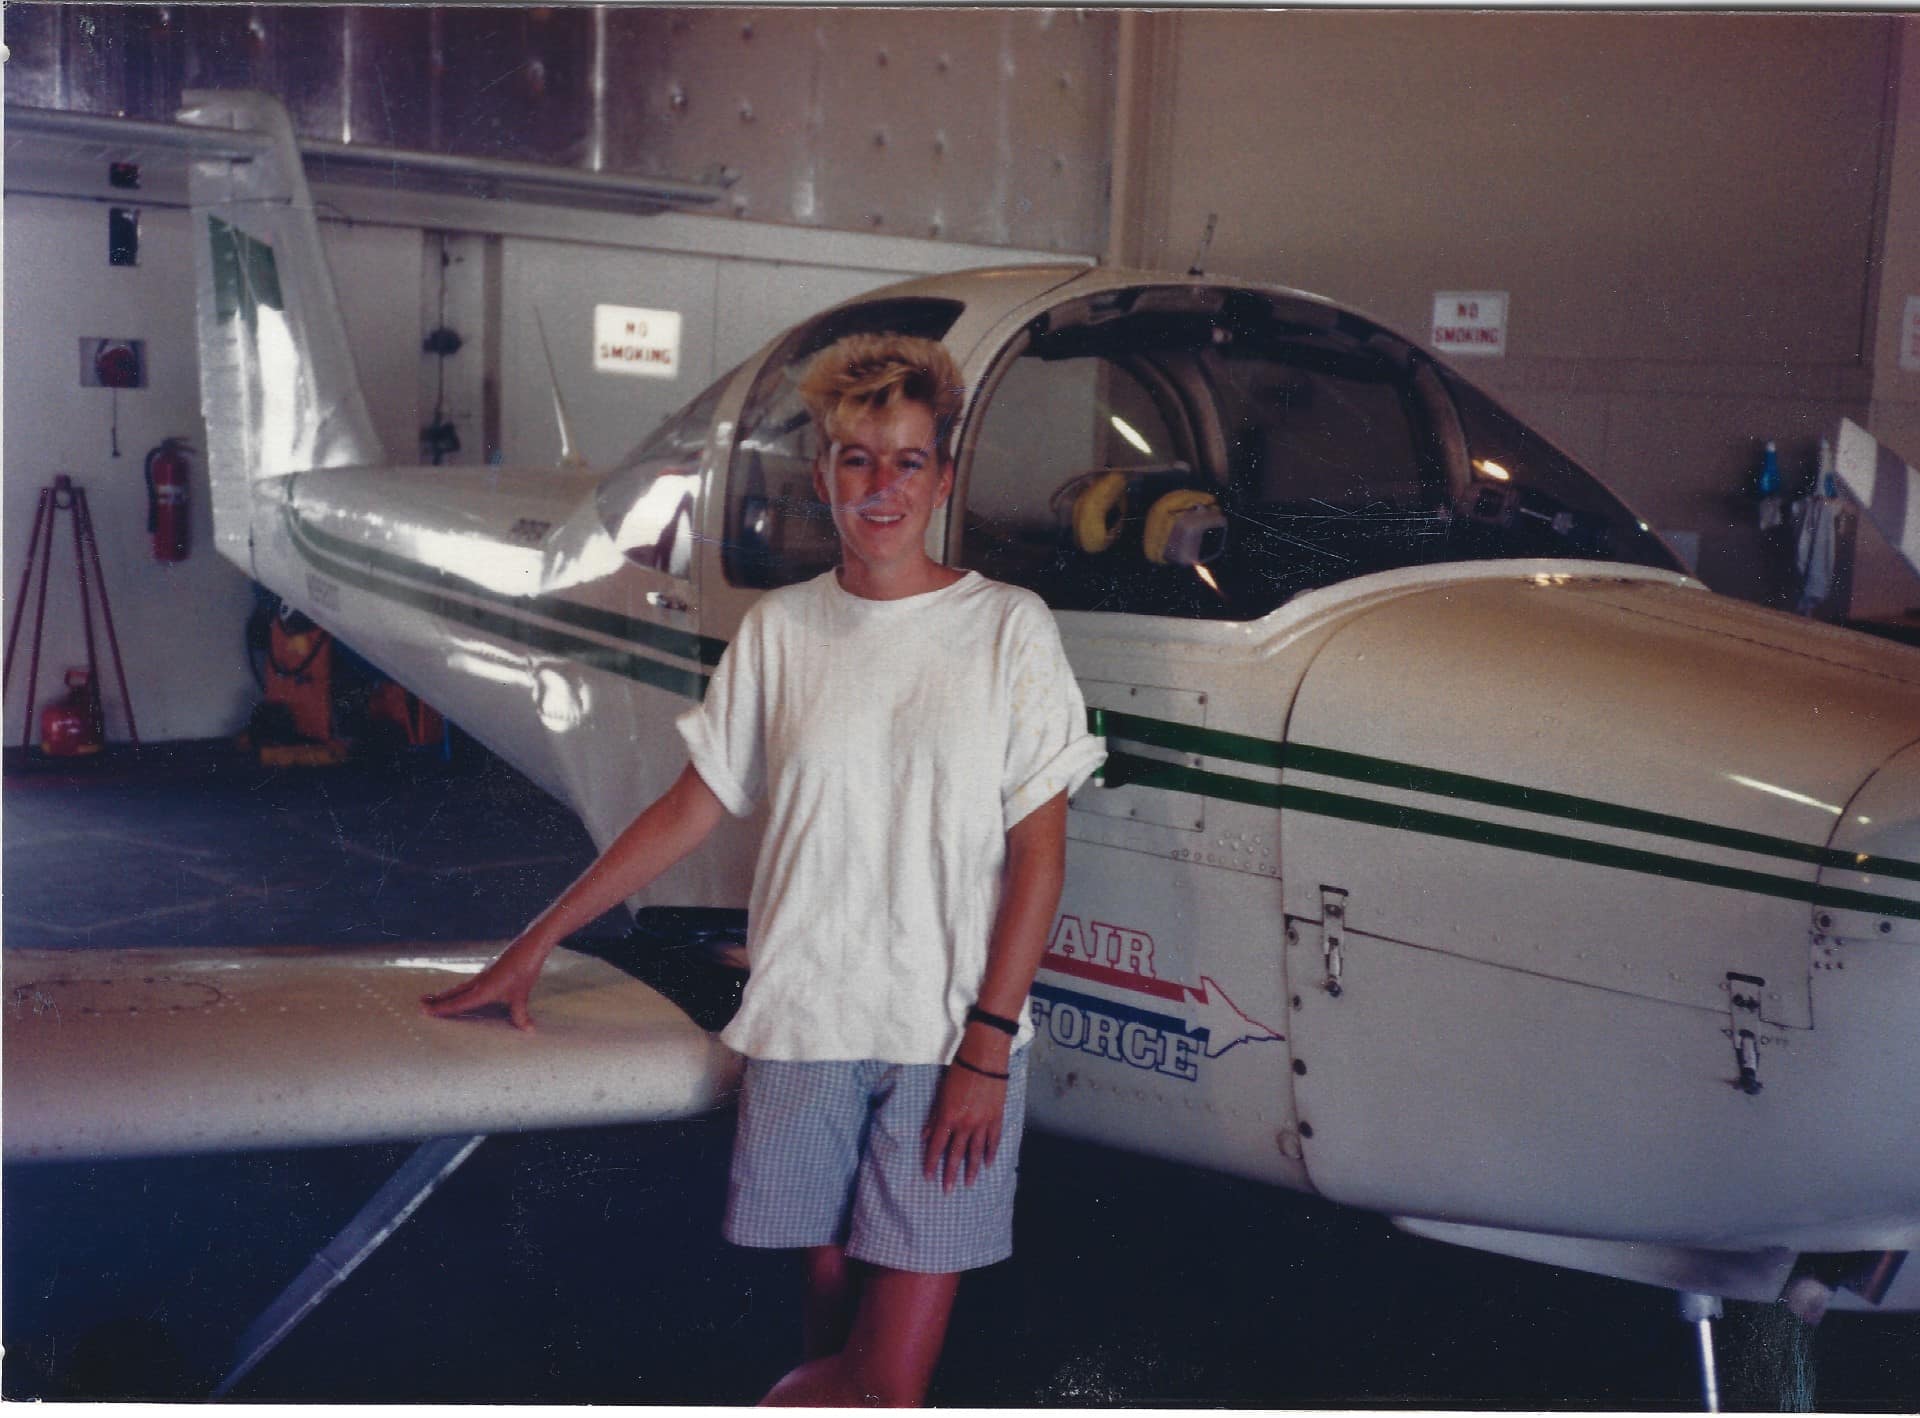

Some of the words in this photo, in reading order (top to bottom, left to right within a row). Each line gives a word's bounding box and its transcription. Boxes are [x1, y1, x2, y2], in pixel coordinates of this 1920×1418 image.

[1457, 302, 1479, 319] NO
[625, 320, 648, 338] NO
[1435, 327, 1499, 345] SMOKING
[600, 343, 672, 365] SMOKING
[1050, 915, 1157, 979] AIR
